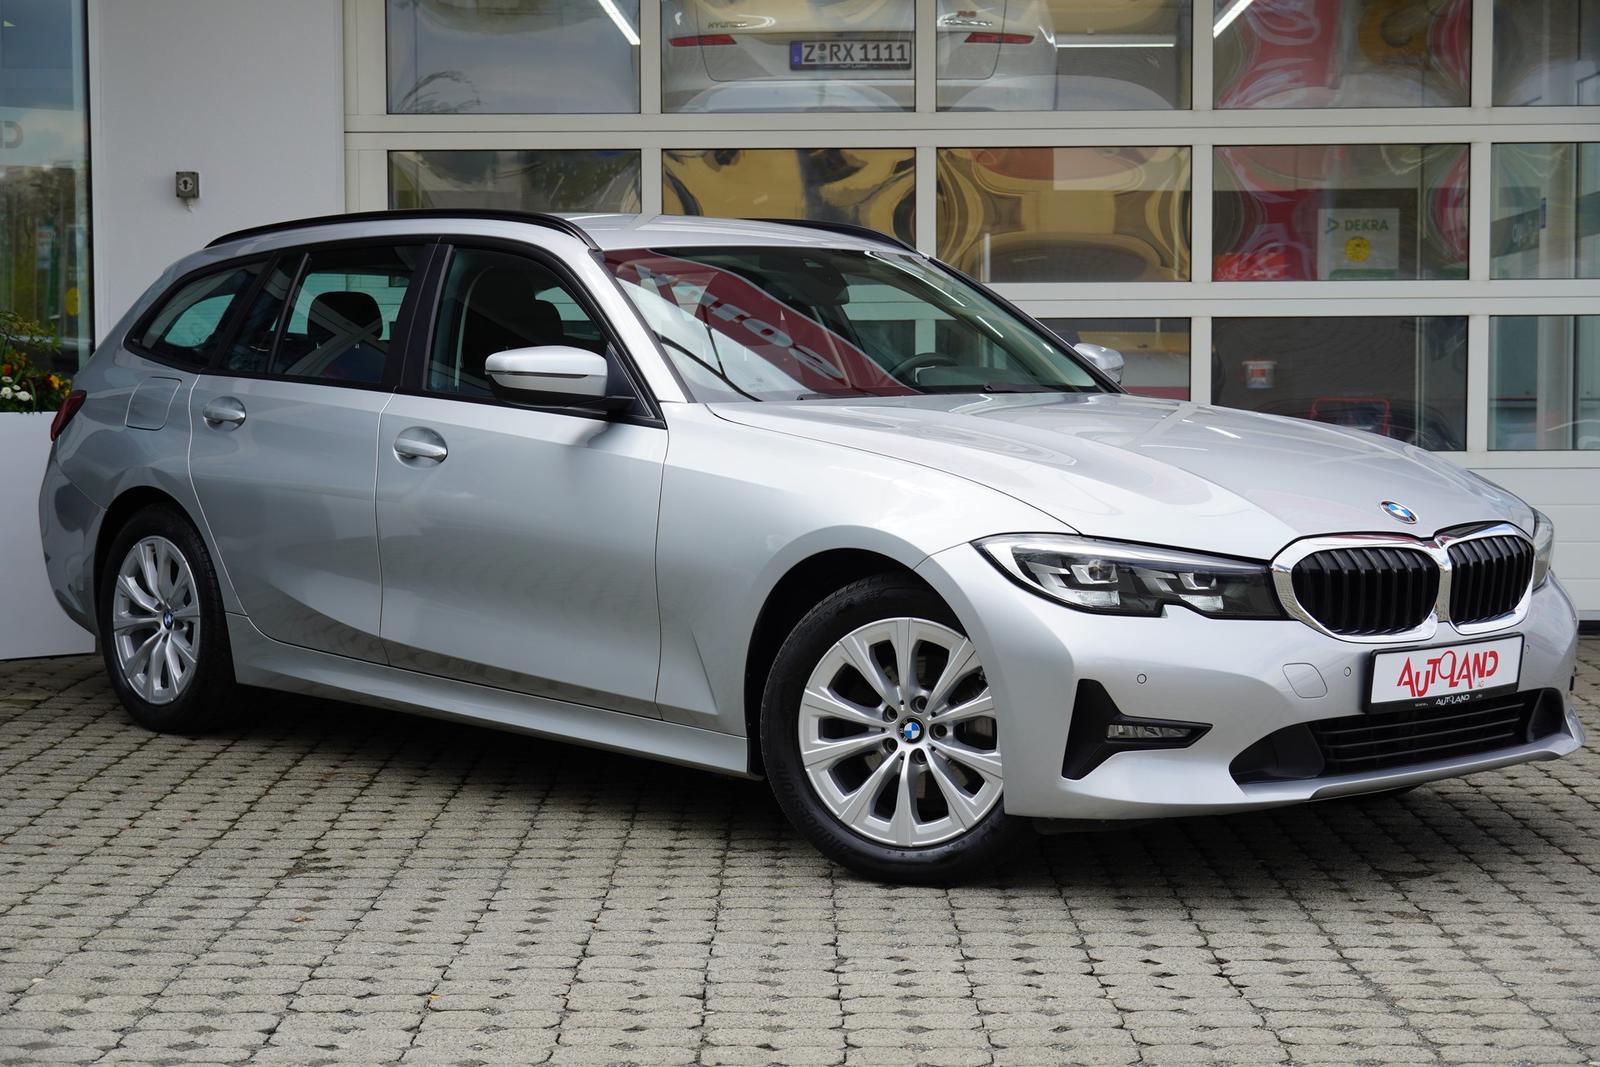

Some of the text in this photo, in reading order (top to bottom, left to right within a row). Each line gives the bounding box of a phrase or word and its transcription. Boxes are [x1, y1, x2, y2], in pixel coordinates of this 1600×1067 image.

[803, 44, 816, 63] Z
[829, 44, 855, 62] RX
[859, 43, 908, 62] 1111
[1344, 218, 1390, 232] DEKRA
